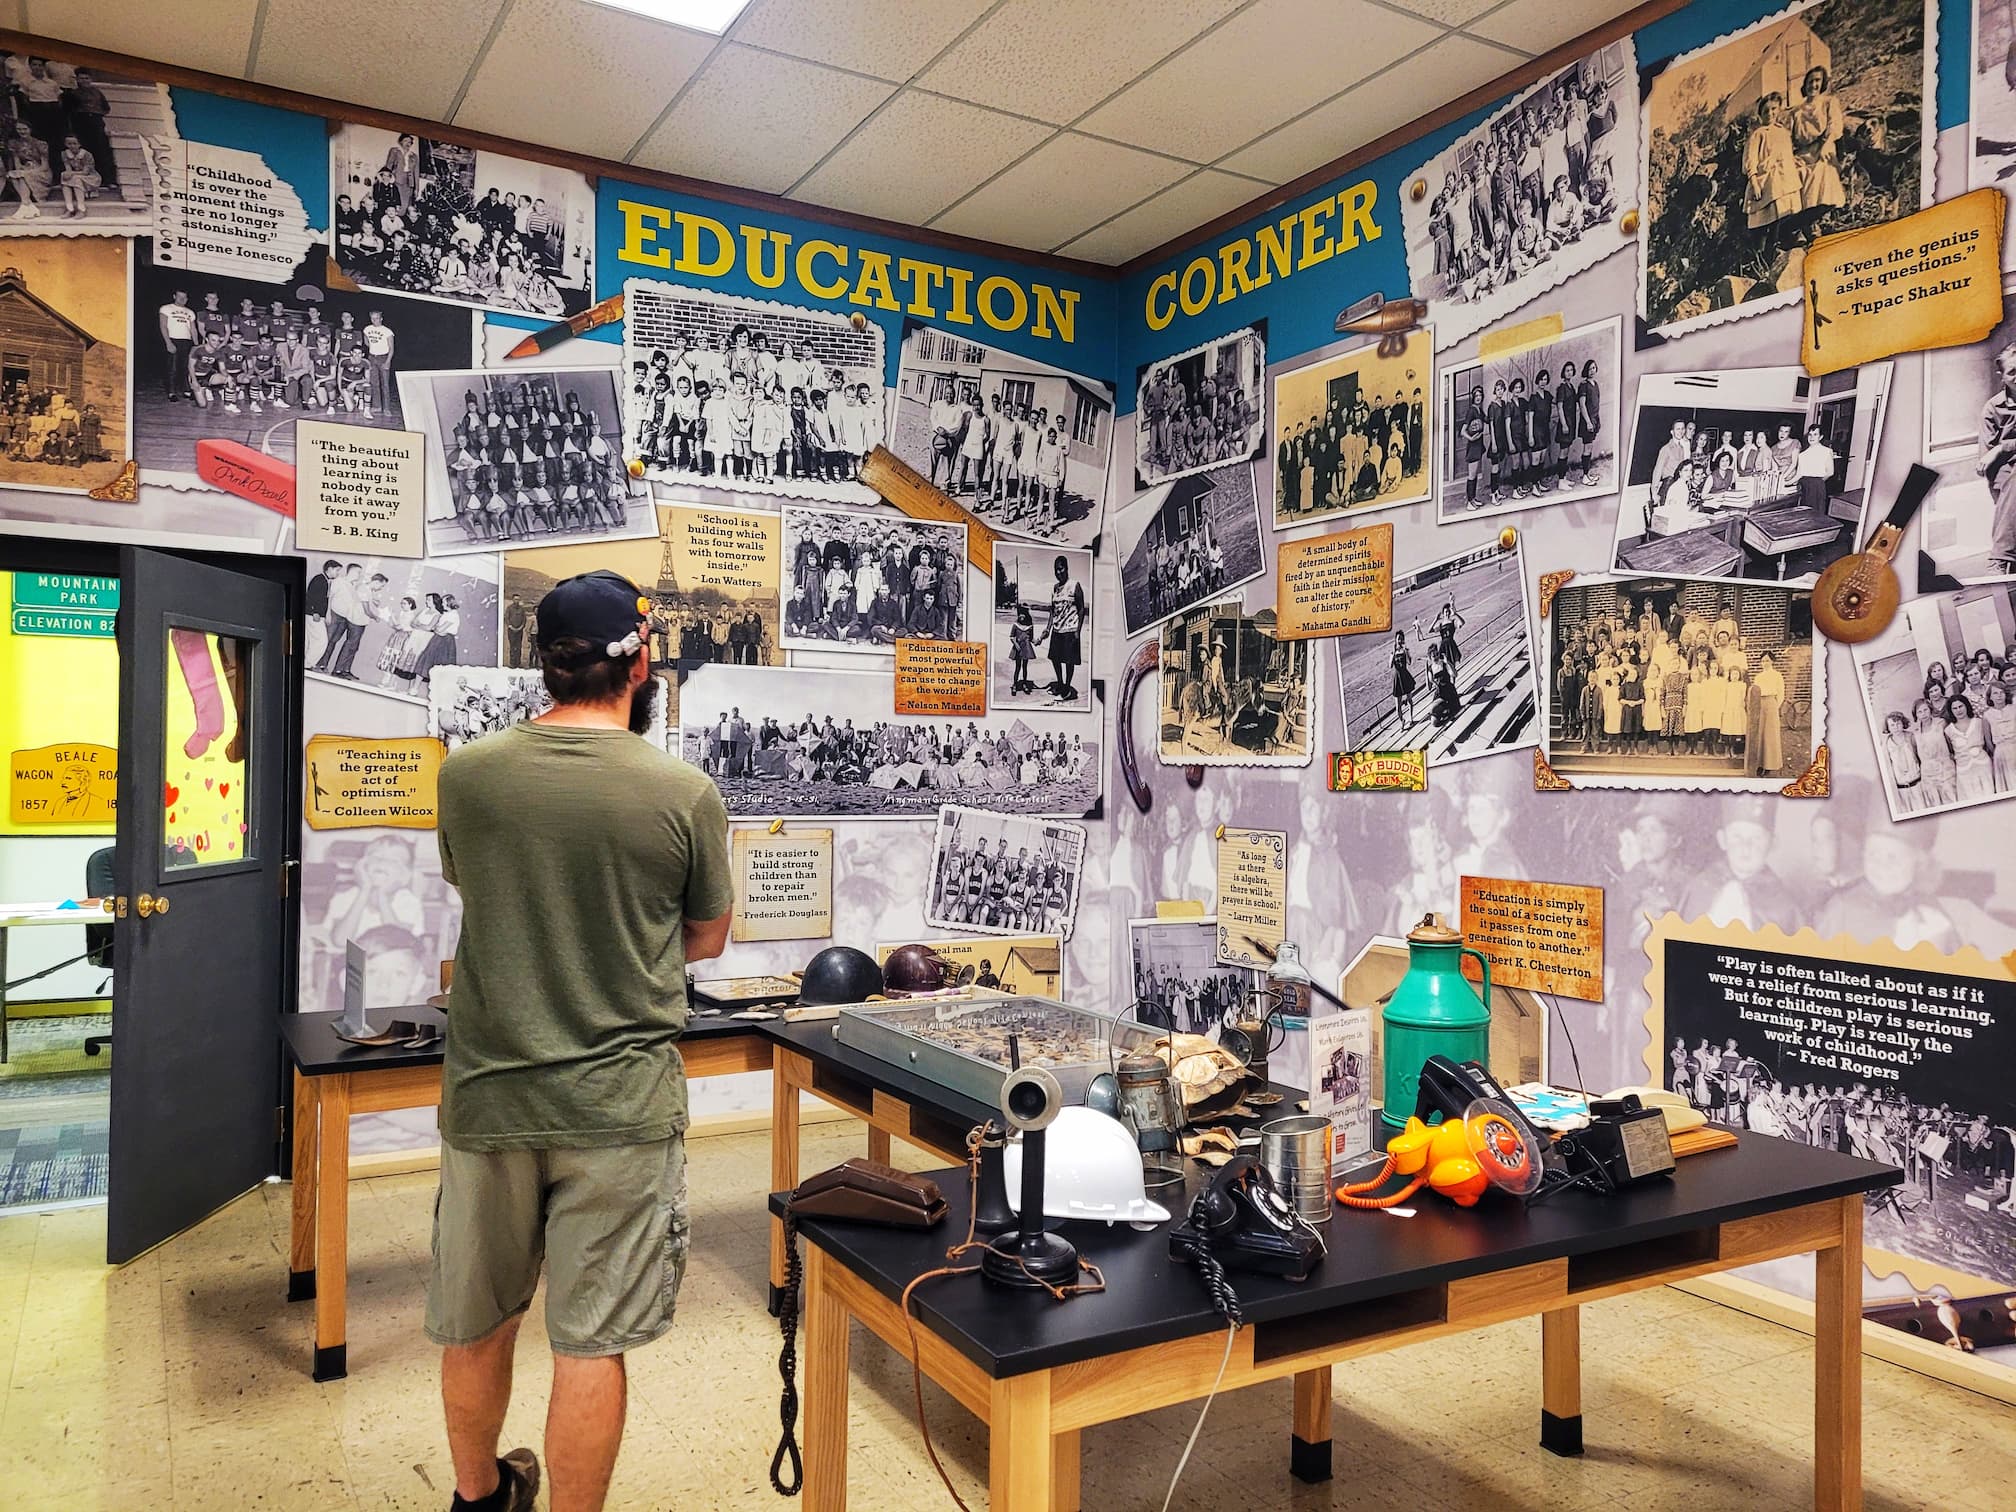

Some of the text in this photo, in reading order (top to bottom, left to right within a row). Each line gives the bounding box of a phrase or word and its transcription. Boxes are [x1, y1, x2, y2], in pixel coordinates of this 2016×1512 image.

[187, 165, 272, 188] “Childhood
[192, 179, 267, 200] is over the
[173, 192, 284, 217] moment things
[181, 207, 278, 229] are no longer
[177, 237, 292, 264] Eugene Ionesco
[1888, 248, 1913, 263] the
[1919, 229, 1979, 255] genius
[1145, 179, 1381, 331] CORNER
[618, 200, 1080, 343] EDUCATION
[1836, 277, 1872, 294] asks
[1852, 276, 1972, 316] Tupac Shakur
[349, 443, 409, 459] beautiful
[322, 455, 399, 470] thing about
[323, 467, 397, 483] learning is
[322, 481, 399, 496] nobody can
[320, 494, 400, 510] take it away
[325, 506, 358, 518] from
[741, 519, 750, 527] is
[333, 525, 398, 541] B. B. King
[688, 524, 767, 539] building which
[691, 536, 763, 550] has four walls
[1314, 543, 1335, 554] small
[1338, 540, 1357, 549] body
[1360, 537, 1367, 546] of
[689, 549, 765, 561] with tomorrow
[39, 576, 116, 590] MOUNTAIN
[701, 575, 762, 587] Lon Watters
[61, 592, 97, 604] PARK
[19, 616, 92, 631] ELEVATION
[1302, 616, 1371, 631] Mahatma Gandhi
[966, 647, 979, 655] the
[907, 701, 980, 710] Nelson Mandela
[55, 752, 98, 763] BEALE
[410, 751, 421, 759] is
[15, 770, 53, 780] WAGON
[340, 763, 418, 774] the greatest
[1357, 760, 1420, 777] MY BUDDIE
[385, 776, 398, 784] of
[21, 800, 48, 809] 1857
[335, 806, 433, 816] Colleen Wilcox
[777, 849, 808, 857] easier
[753, 861, 813, 870] build strong
[749, 871, 816, 880] children than
[1534, 896, 1542, 906] is
[1546, 899, 1585, 913] simply
[745, 910, 827, 919] Frederick Douglass
[1234, 912, 1277, 926] Larry Miller
[1470, 904, 1485, 913] the
[1488, 906, 1508, 916] soul
[1512, 909, 1522, 918] of
[1534, 912, 1573, 927] society
[1576, 918, 1588, 926] as
[1480, 919, 1576, 940] it passes from one
[1469, 932, 1523, 947] generation
[1526, 939, 1535, 949] to
[1516, 958, 1527, 969] K.
[1530, 960, 1591, 978] Chesterton
[1760, 961, 1774, 974] is
[1777, 965, 1816, 981] often
[1819, 970, 1871, 988] talked
[1875, 977, 1924, 995] about
[1928, 986, 1948, 998] as
[1952, 986, 1966, 1001] if
[1970, 989, 1984, 1003] it
[1708, 972, 1995, 1026] were a relief from serious learning.
[1724, 989, 1973, 1039] But for children play is serious
[1740, 1007, 1952, 1054] learning. Play is really the
[1764, 1028, 1802, 1045] work
[1806, 1034, 1823, 1048] of
[1800, 1050, 1899, 1080] Fred Rogers
